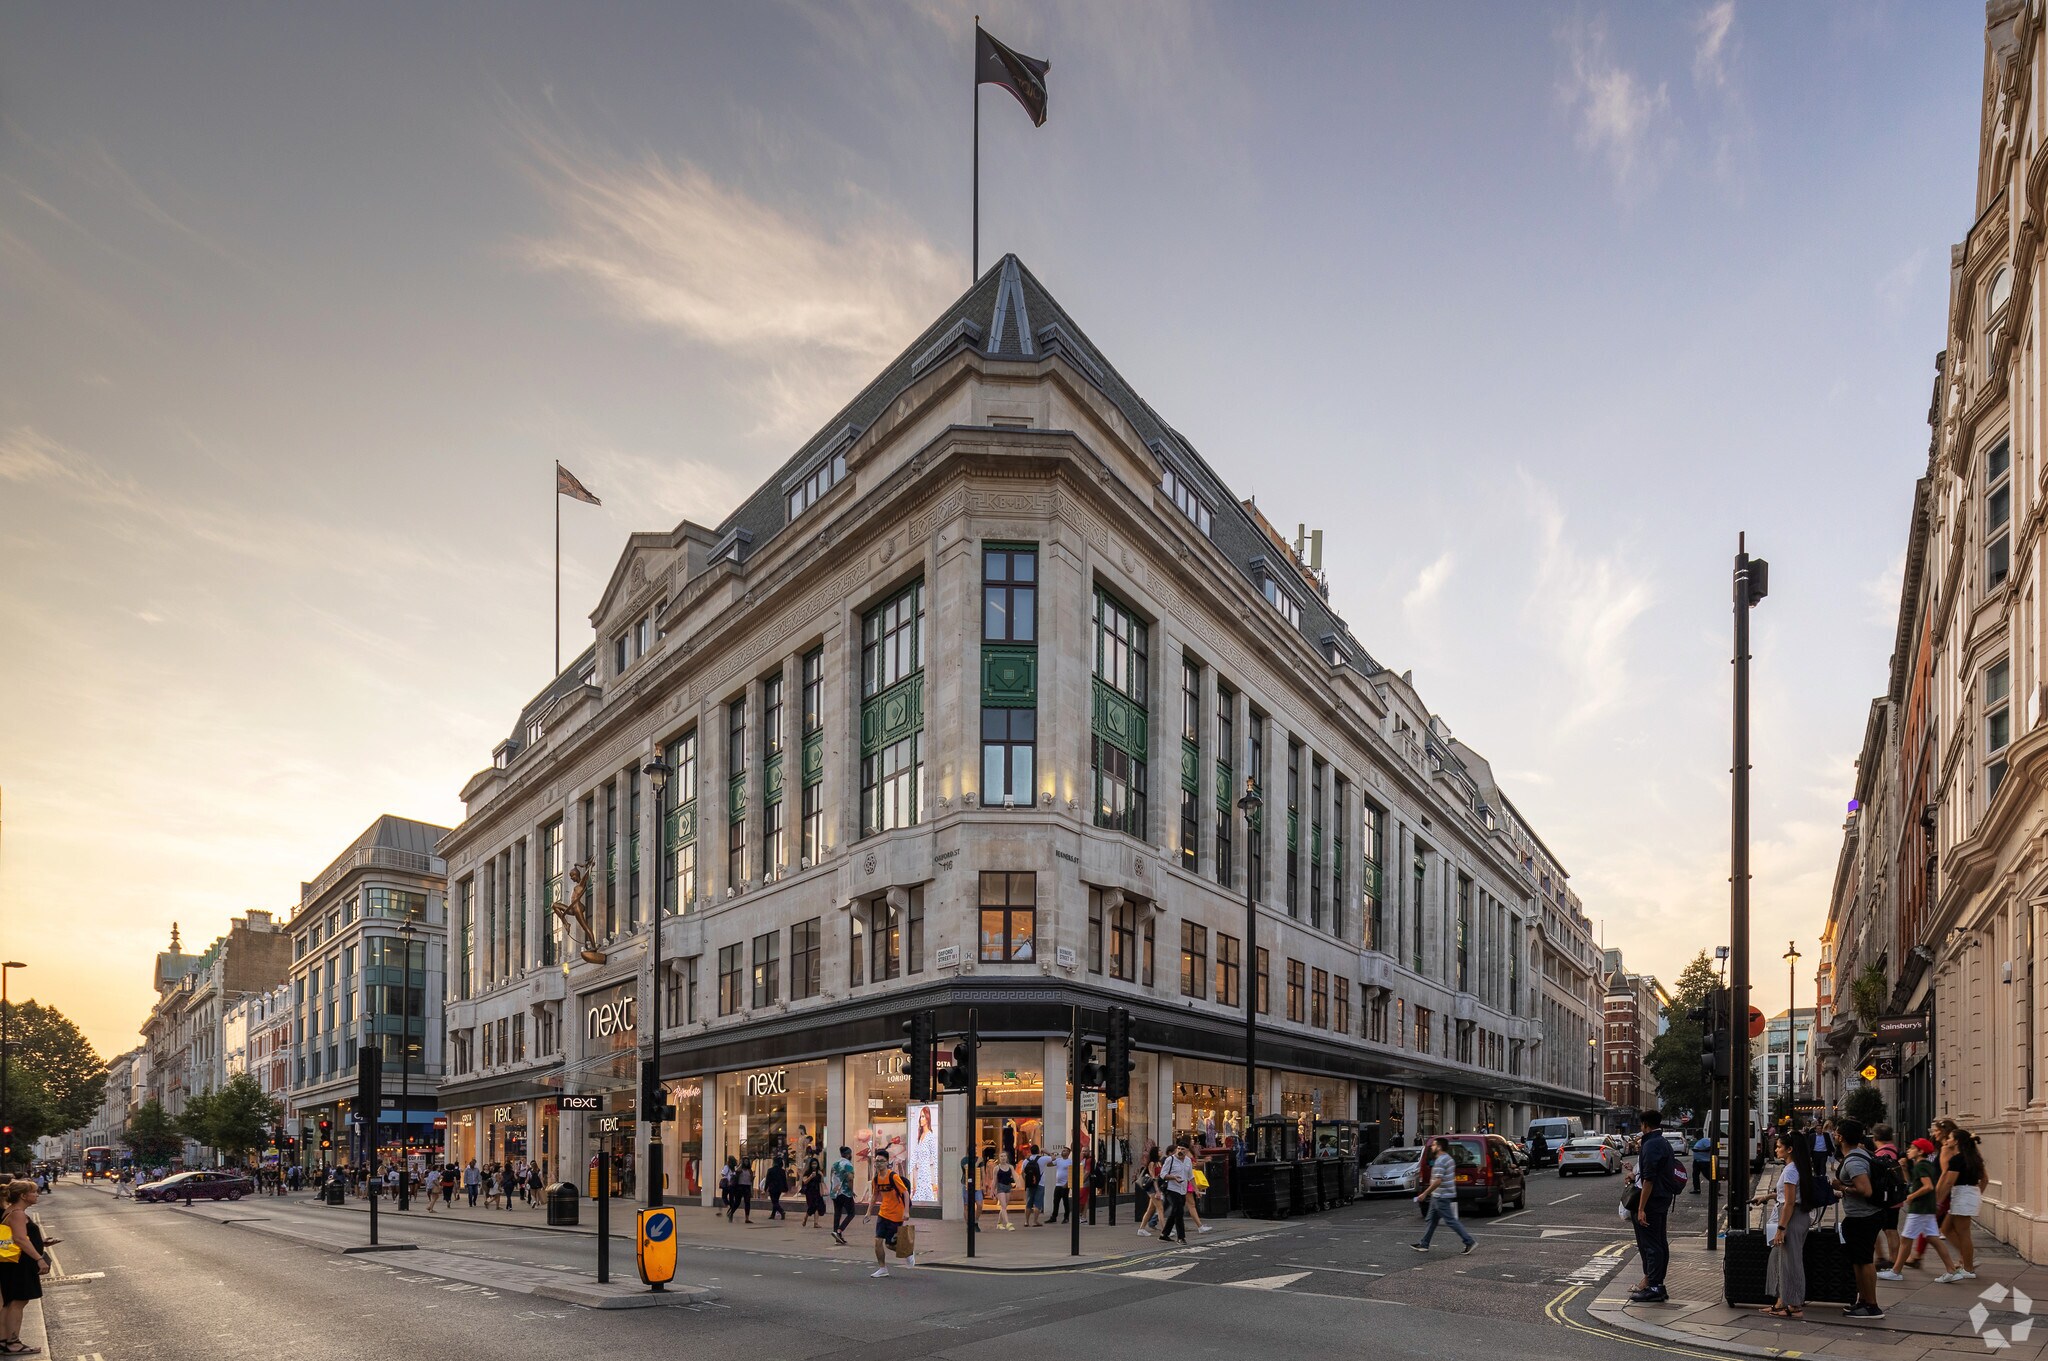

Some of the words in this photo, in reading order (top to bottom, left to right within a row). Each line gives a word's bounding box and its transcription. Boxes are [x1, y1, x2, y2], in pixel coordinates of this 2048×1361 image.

[938, 948, 953, 957] OXFORD
[938, 955, 951, 963] STREET
[588, 996, 634, 1039] next
[1880, 1021, 1922, 1031] Sainsbury's
[936, 1060, 951, 1068] OSTA
[747, 1070, 787, 1096] next
[563, 1097, 597, 1109] next
[494, 1106, 512, 1122] next
[600, 1117, 619, 1132] next
